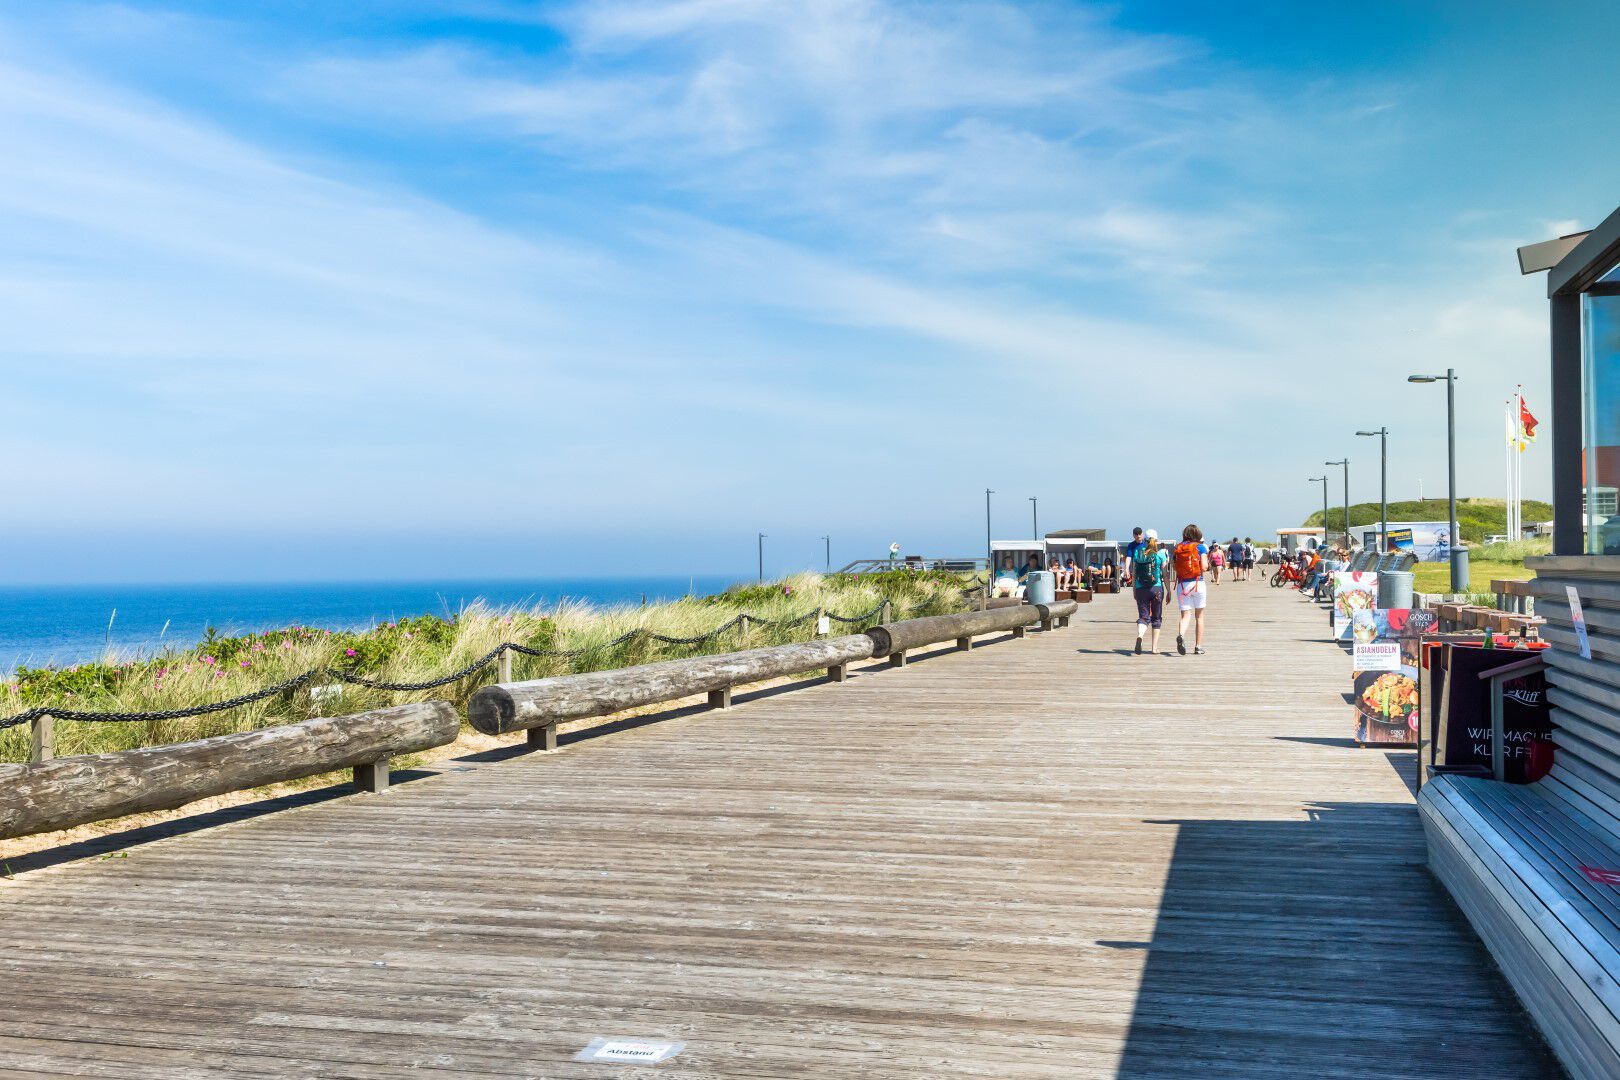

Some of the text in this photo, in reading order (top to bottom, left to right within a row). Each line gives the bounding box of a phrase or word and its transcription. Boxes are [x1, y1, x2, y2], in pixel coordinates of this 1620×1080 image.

[1409, 613, 1433, 621] GOSCH
[1356, 645, 1397, 654] ASIANUDELN
[1515, 689, 1541, 703] Kliff
[1473, 743, 1511, 757] KLR
